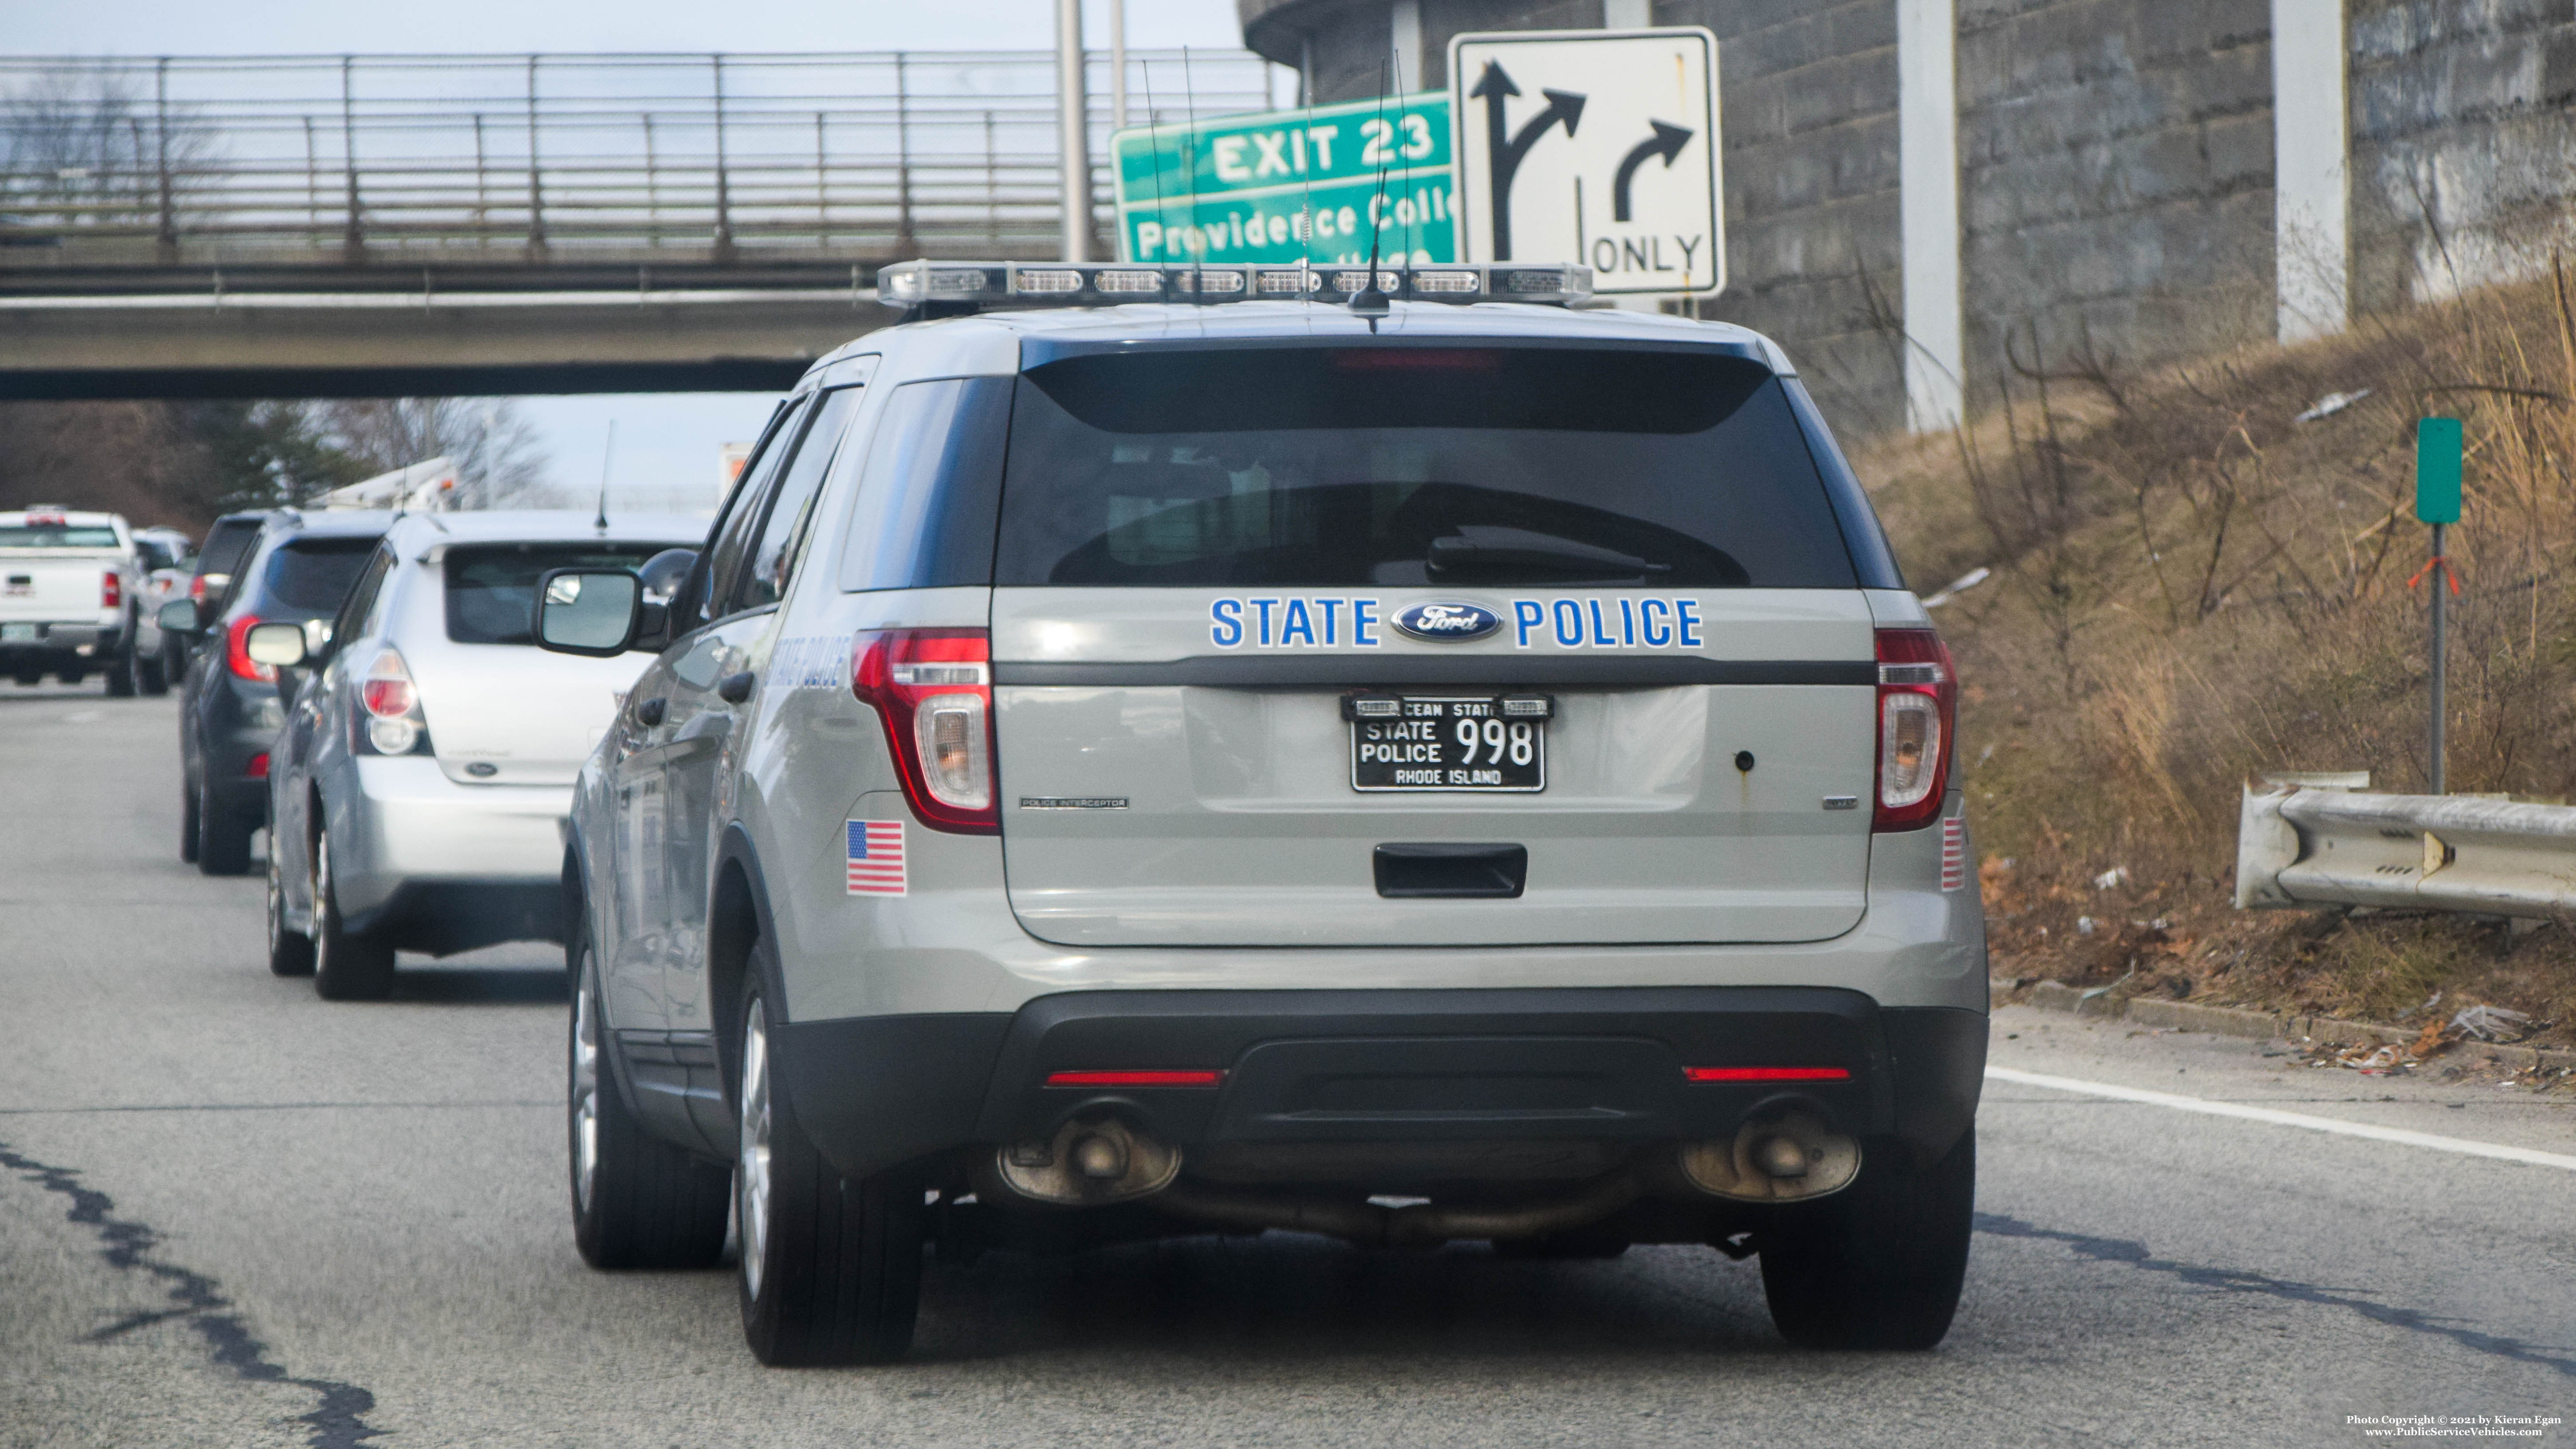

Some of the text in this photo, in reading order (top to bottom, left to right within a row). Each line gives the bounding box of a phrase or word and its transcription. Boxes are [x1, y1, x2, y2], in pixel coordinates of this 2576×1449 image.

[1212, 114, 1435, 183] EXIT 23
[1136, 206, 1357, 260] Providence
[1593, 234, 1702, 273] ONLY
[1209, 596, 1705, 650] STATE POLICE
[1417, 605, 1480, 630] Ford
[1404, 704, 1442, 716] CEAN
[1367, 721, 1436, 740] STATE
[1456, 718, 1533, 766] 998
[1361, 744, 1443, 763] POLICE
[1396, 769, 1502, 785] RHODE ISLAND
